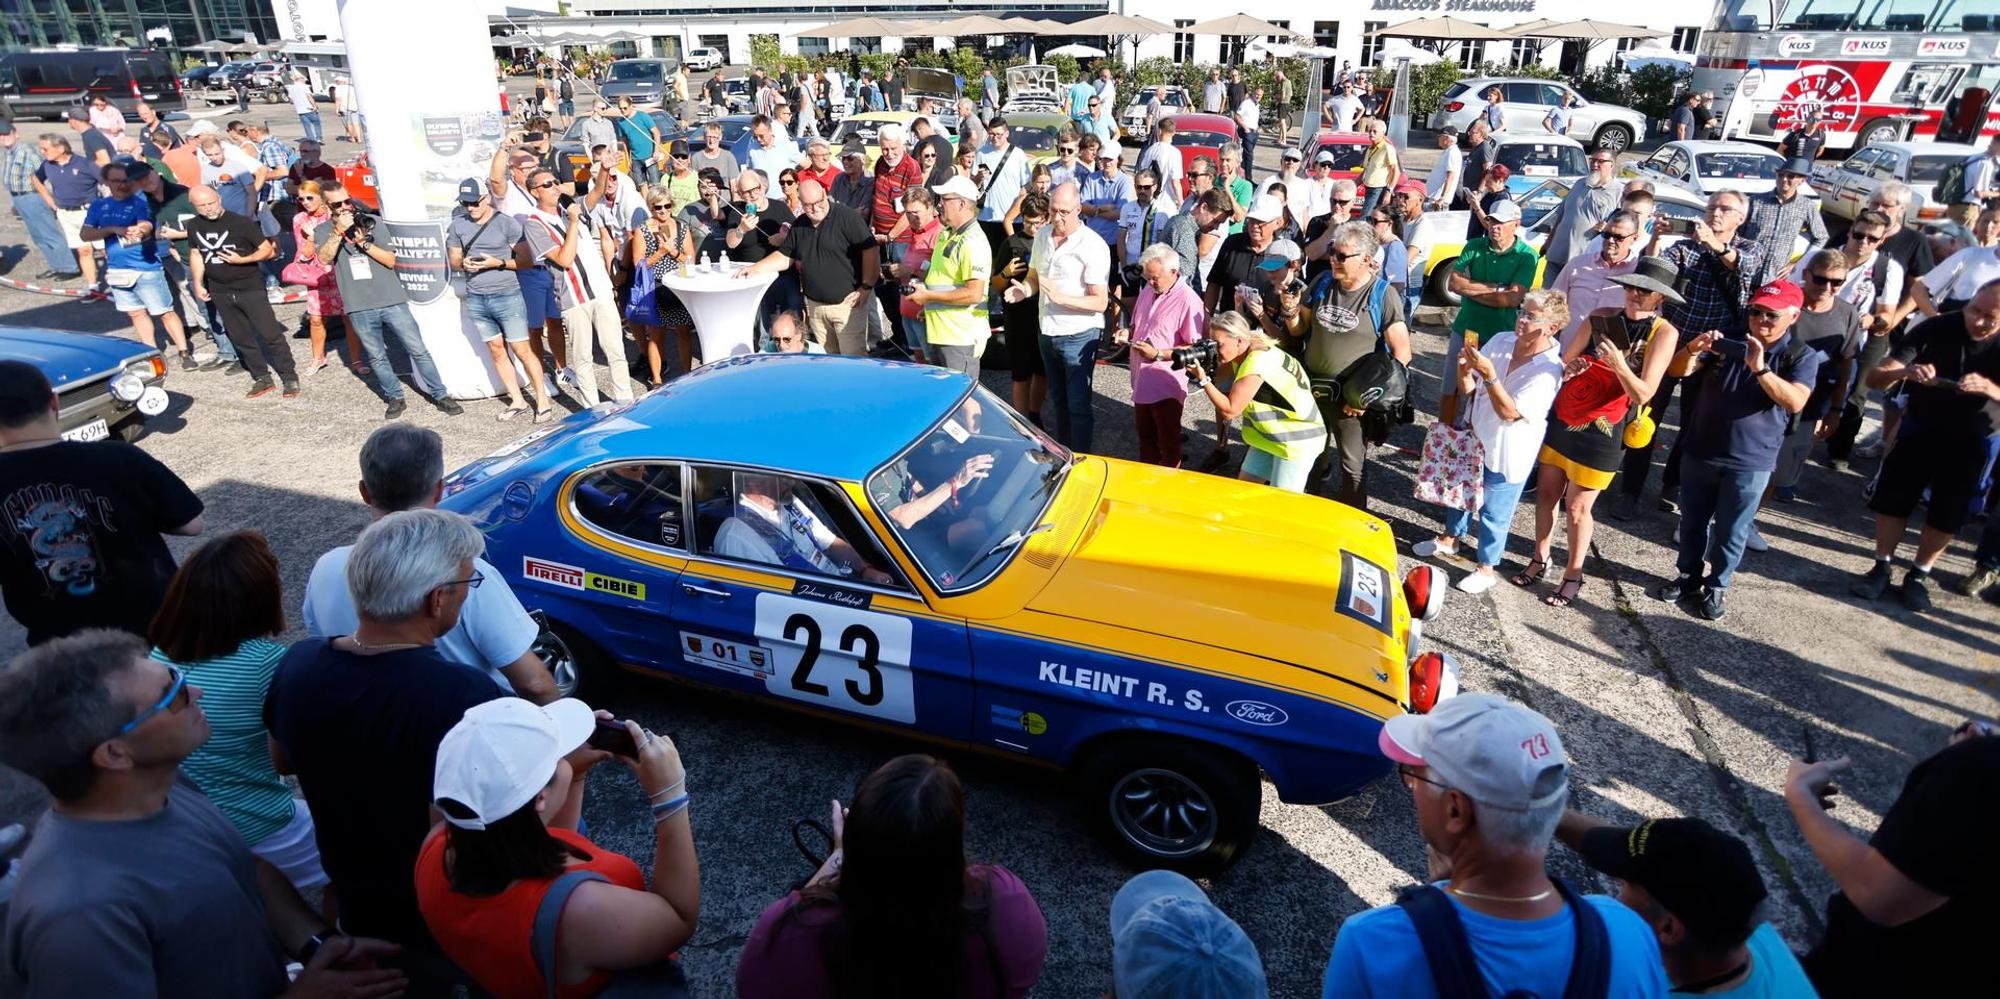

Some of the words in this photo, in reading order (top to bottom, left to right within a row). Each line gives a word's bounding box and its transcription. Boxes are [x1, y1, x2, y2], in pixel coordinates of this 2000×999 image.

[1789, 41, 1811, 50] KUS
[1861, 40, 1887, 50] KUS
[1938, 41, 1966, 50] KUS
[1798, 78, 1810, 92] 12
[1815, 76, 1827, 90] 11
[1827, 81, 1842, 96] 10
[1832, 111, 1845, 119] 8
[387, 236, 439, 247] LYMPIA
[407, 283, 429, 291] 2022
[526, 560, 583, 586] PIRELLI
[1358, 572, 1377, 598] 23
[712, 641, 738, 661] 01
[782, 612, 884, 706] 23
[1038, 662, 1140, 698] KLEINT
[1147, 680, 1174, 706] R.
[1185, 689, 1210, 713] S.
[1236, 702, 1275, 722] Ford
[1521, 732, 1550, 760] 73
